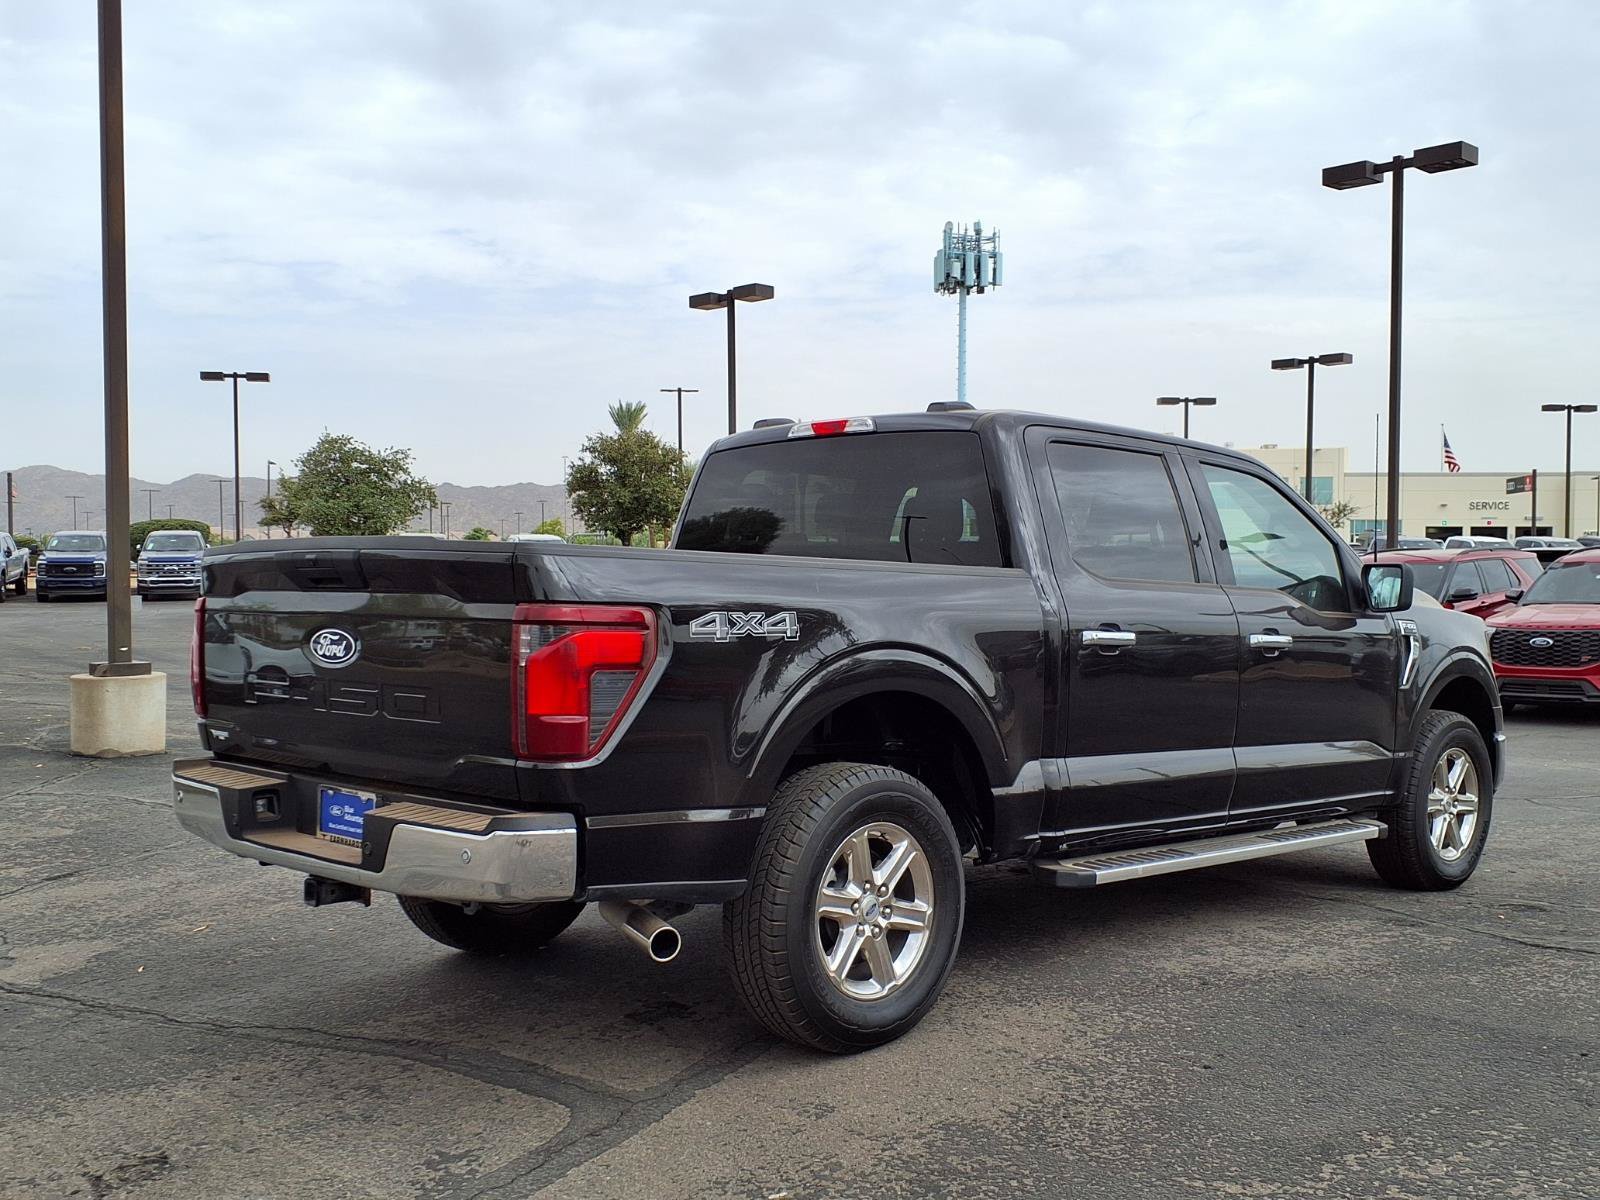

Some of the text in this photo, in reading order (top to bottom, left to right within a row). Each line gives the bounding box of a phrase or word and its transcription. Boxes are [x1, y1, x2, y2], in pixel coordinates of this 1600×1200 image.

[1469, 501, 1510, 511] SERVICE
[315, 632, 349, 658] Ford
[244, 672, 441, 724] F-150
[344, 813, 364, 824] Advantag
